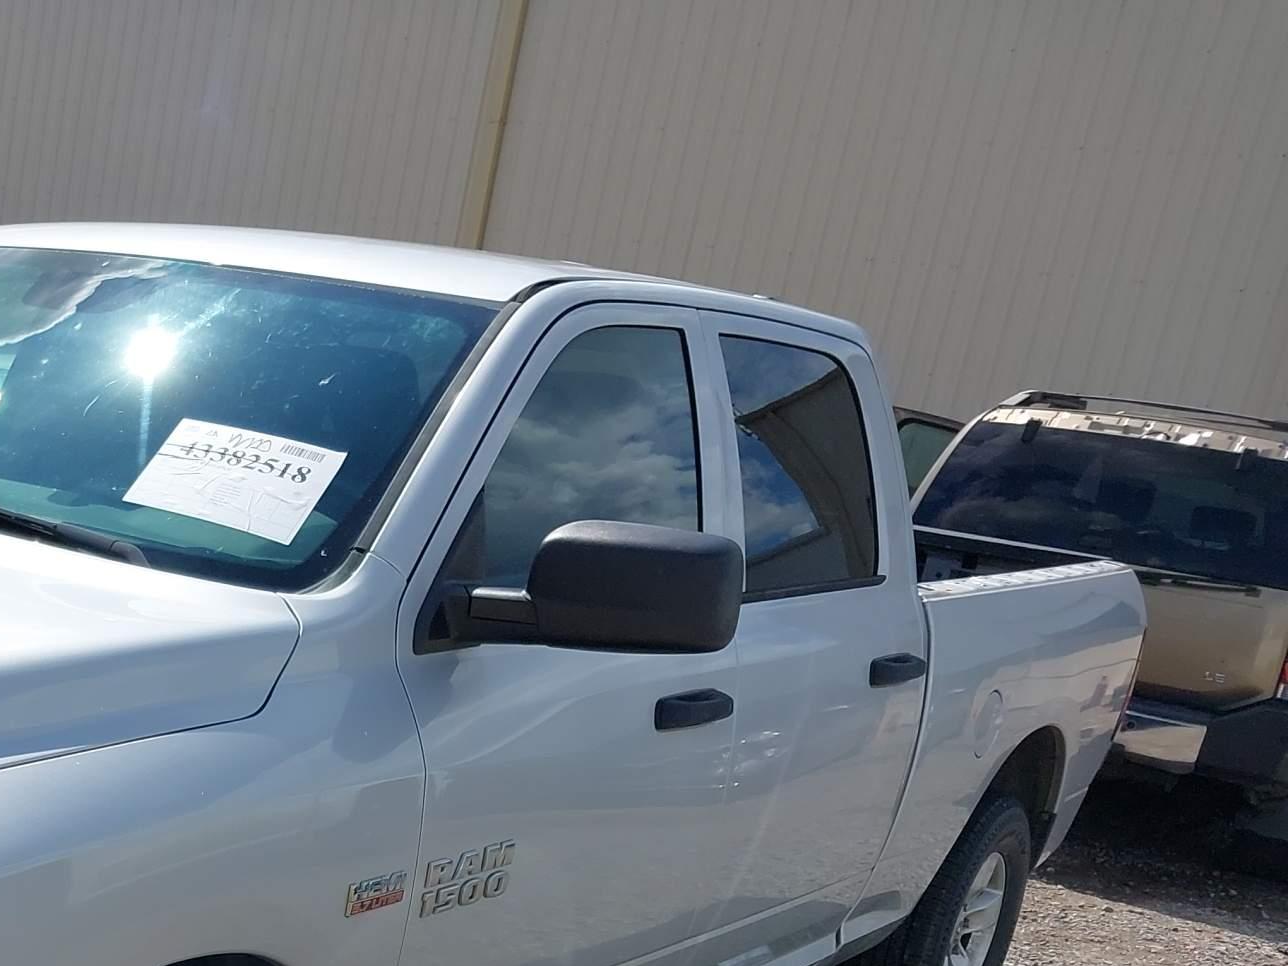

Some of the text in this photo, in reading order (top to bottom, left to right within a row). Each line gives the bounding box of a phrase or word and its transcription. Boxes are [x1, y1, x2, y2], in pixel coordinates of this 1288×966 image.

[180, 441, 312, 484] 43382518
[424, 839, 515, 888] RAM
[420, 870, 509, 918] 1500
